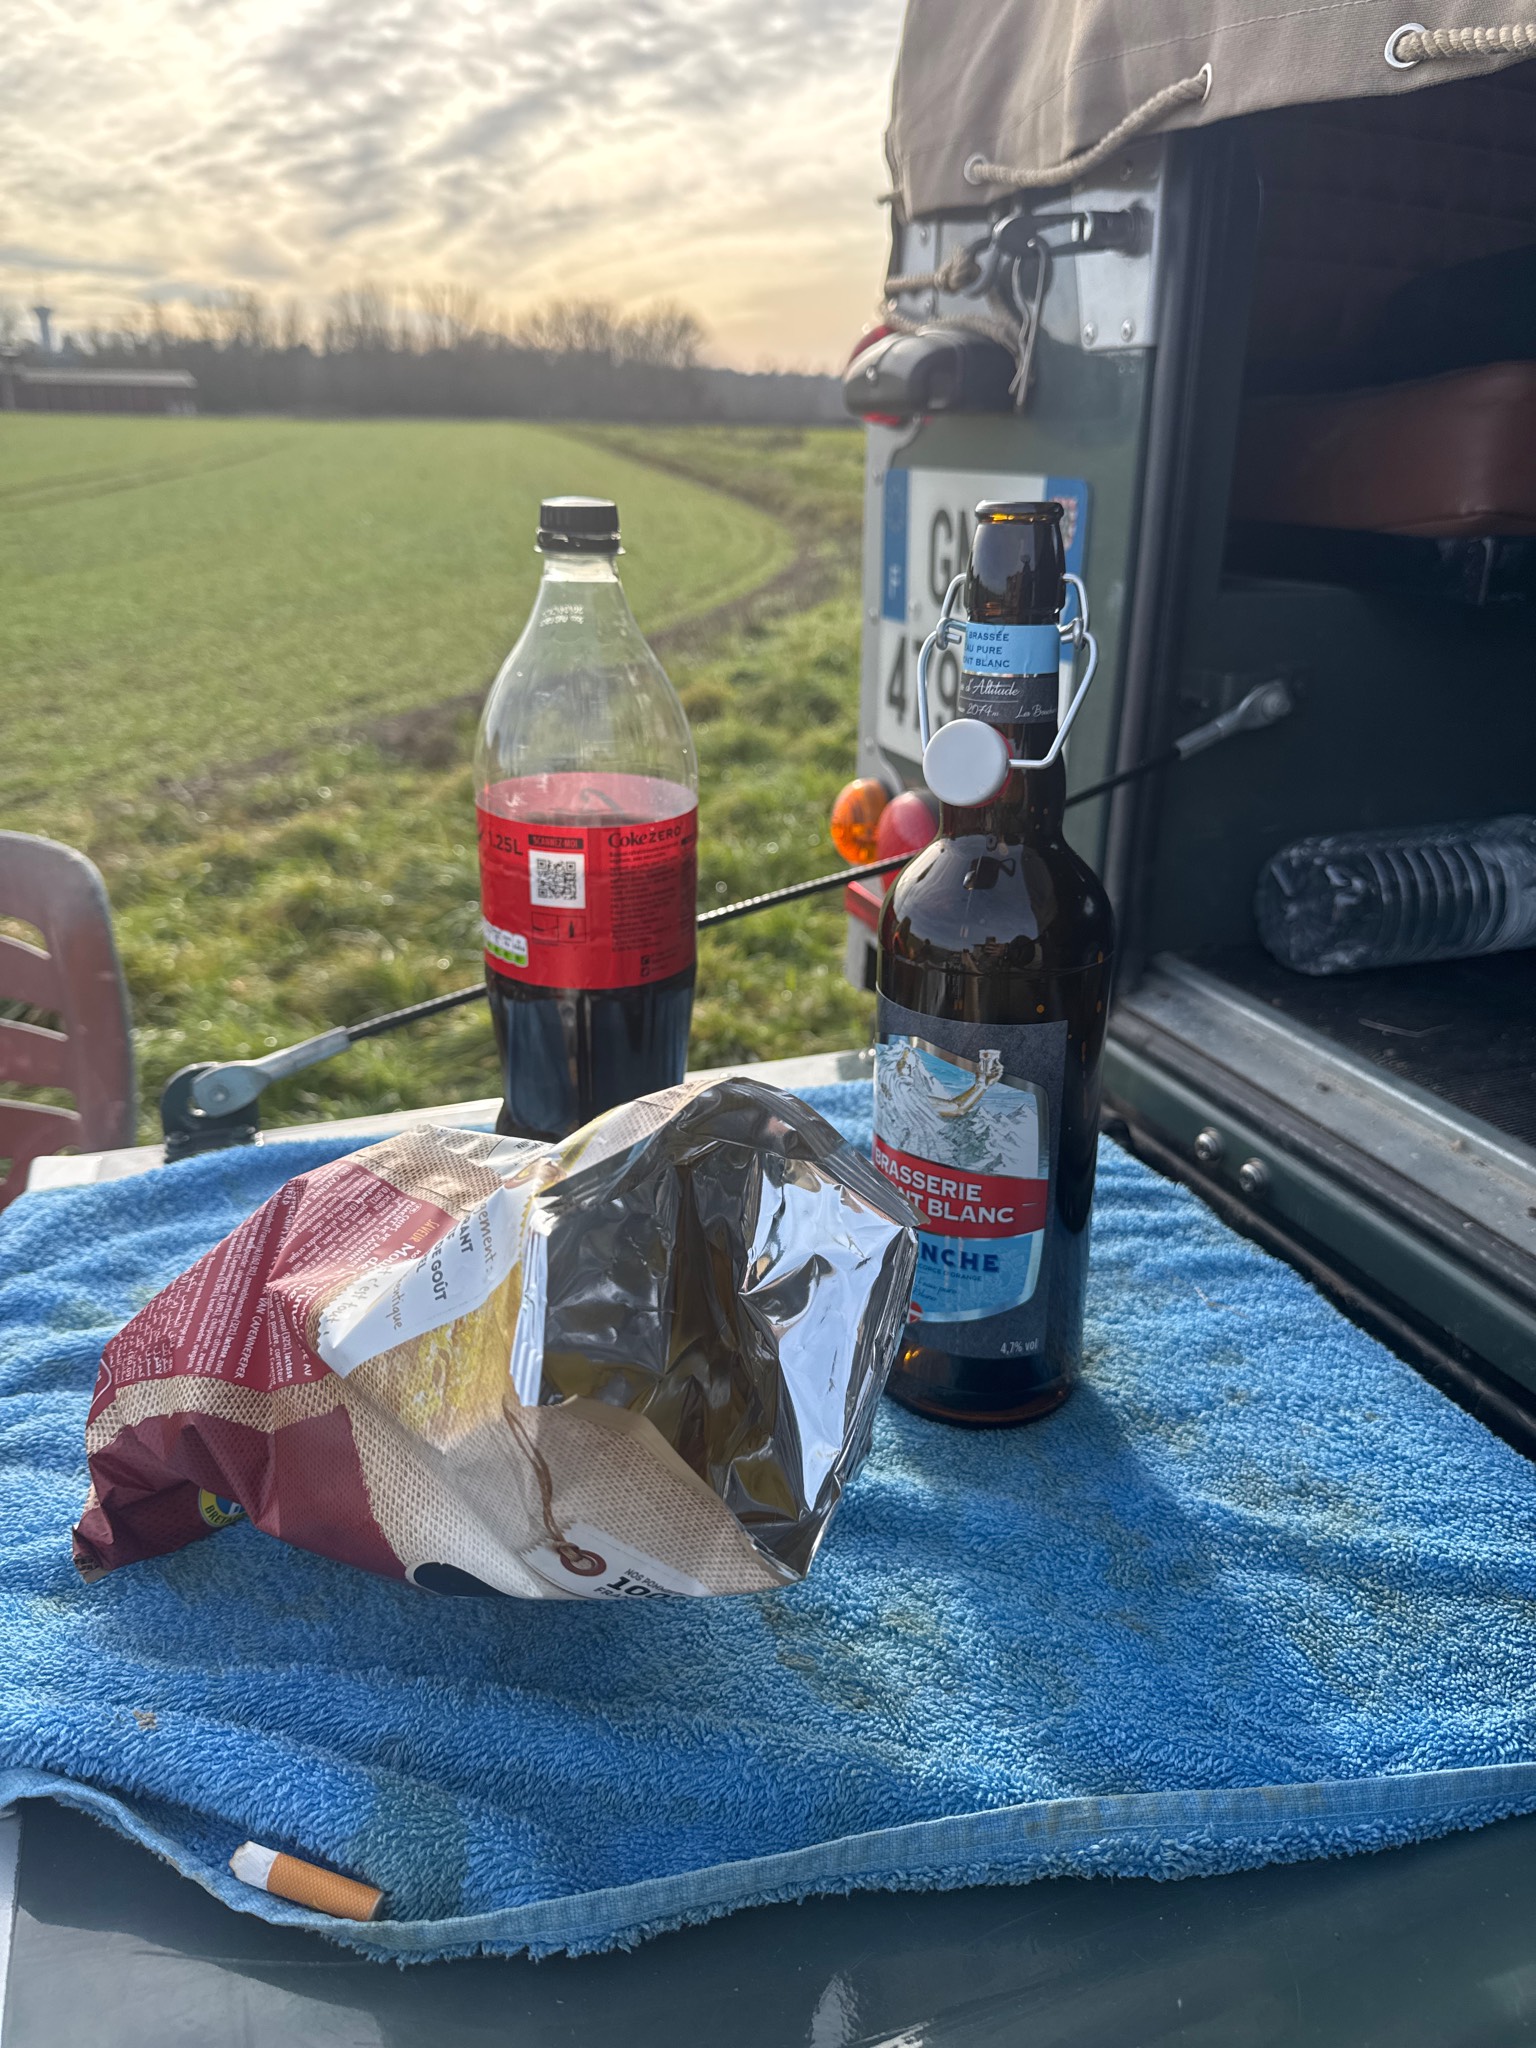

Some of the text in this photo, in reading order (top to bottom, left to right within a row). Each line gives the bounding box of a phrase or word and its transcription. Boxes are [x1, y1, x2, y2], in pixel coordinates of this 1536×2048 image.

[968, 630, 1010, 642] BRASSÉE
[976, 645, 1003, 655] PURE
[975, 658, 1010, 668] BLANC
[608, 825, 682, 848] Coke ZERO
[874, 1147, 982, 1203] BRASSERIE
[355, 1180, 380, 1205] moutarde
[349, 1202, 367, 1221] piment
[927, 1199, 1015, 1225] BLANC
[409, 1217, 439, 1244] SAVEUR
[921, 1241, 1000, 1273] NCHE
[430, 1259, 448, 1300] GOÛT
[255, 1296, 268, 1314] VAN
[275, 1300, 289, 1332] tournesol
[269, 1320, 280, 1346] poudre,
[218, 1335, 233, 1360] lactose,
[233, 1314, 265, 1380] CAYENNEPEPER
[1000, 1338, 1038, 1355] 4,7% vol
[213, 1359, 224, 1375] zout,
[274, 1348, 284, 1382] correcteur
[624, 1568, 645, 1582] NOS
